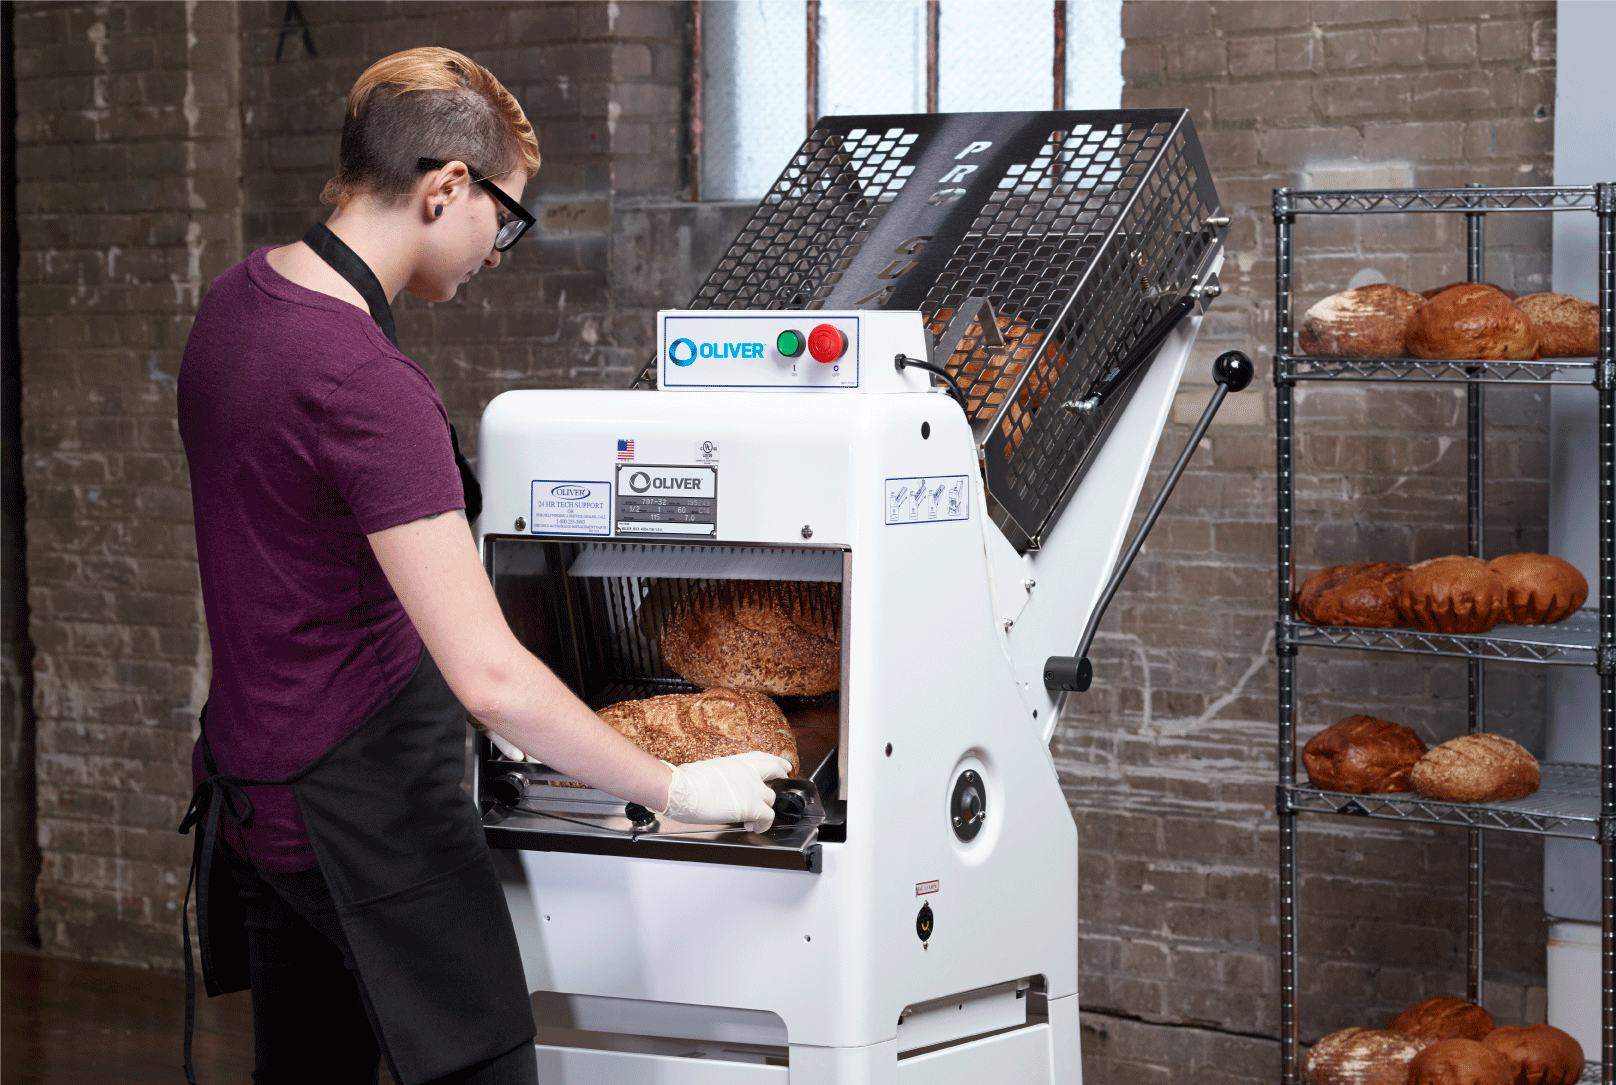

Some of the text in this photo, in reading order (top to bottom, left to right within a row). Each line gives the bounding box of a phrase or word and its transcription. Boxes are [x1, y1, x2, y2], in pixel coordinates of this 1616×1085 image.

[700, 342, 764, 359] OLIVER
[652, 477, 701, 490] OLIVER
[556, 488, 585, 496] OLIVER
[677, 506, 686, 514] 60
[650, 513, 661, 521] 115
